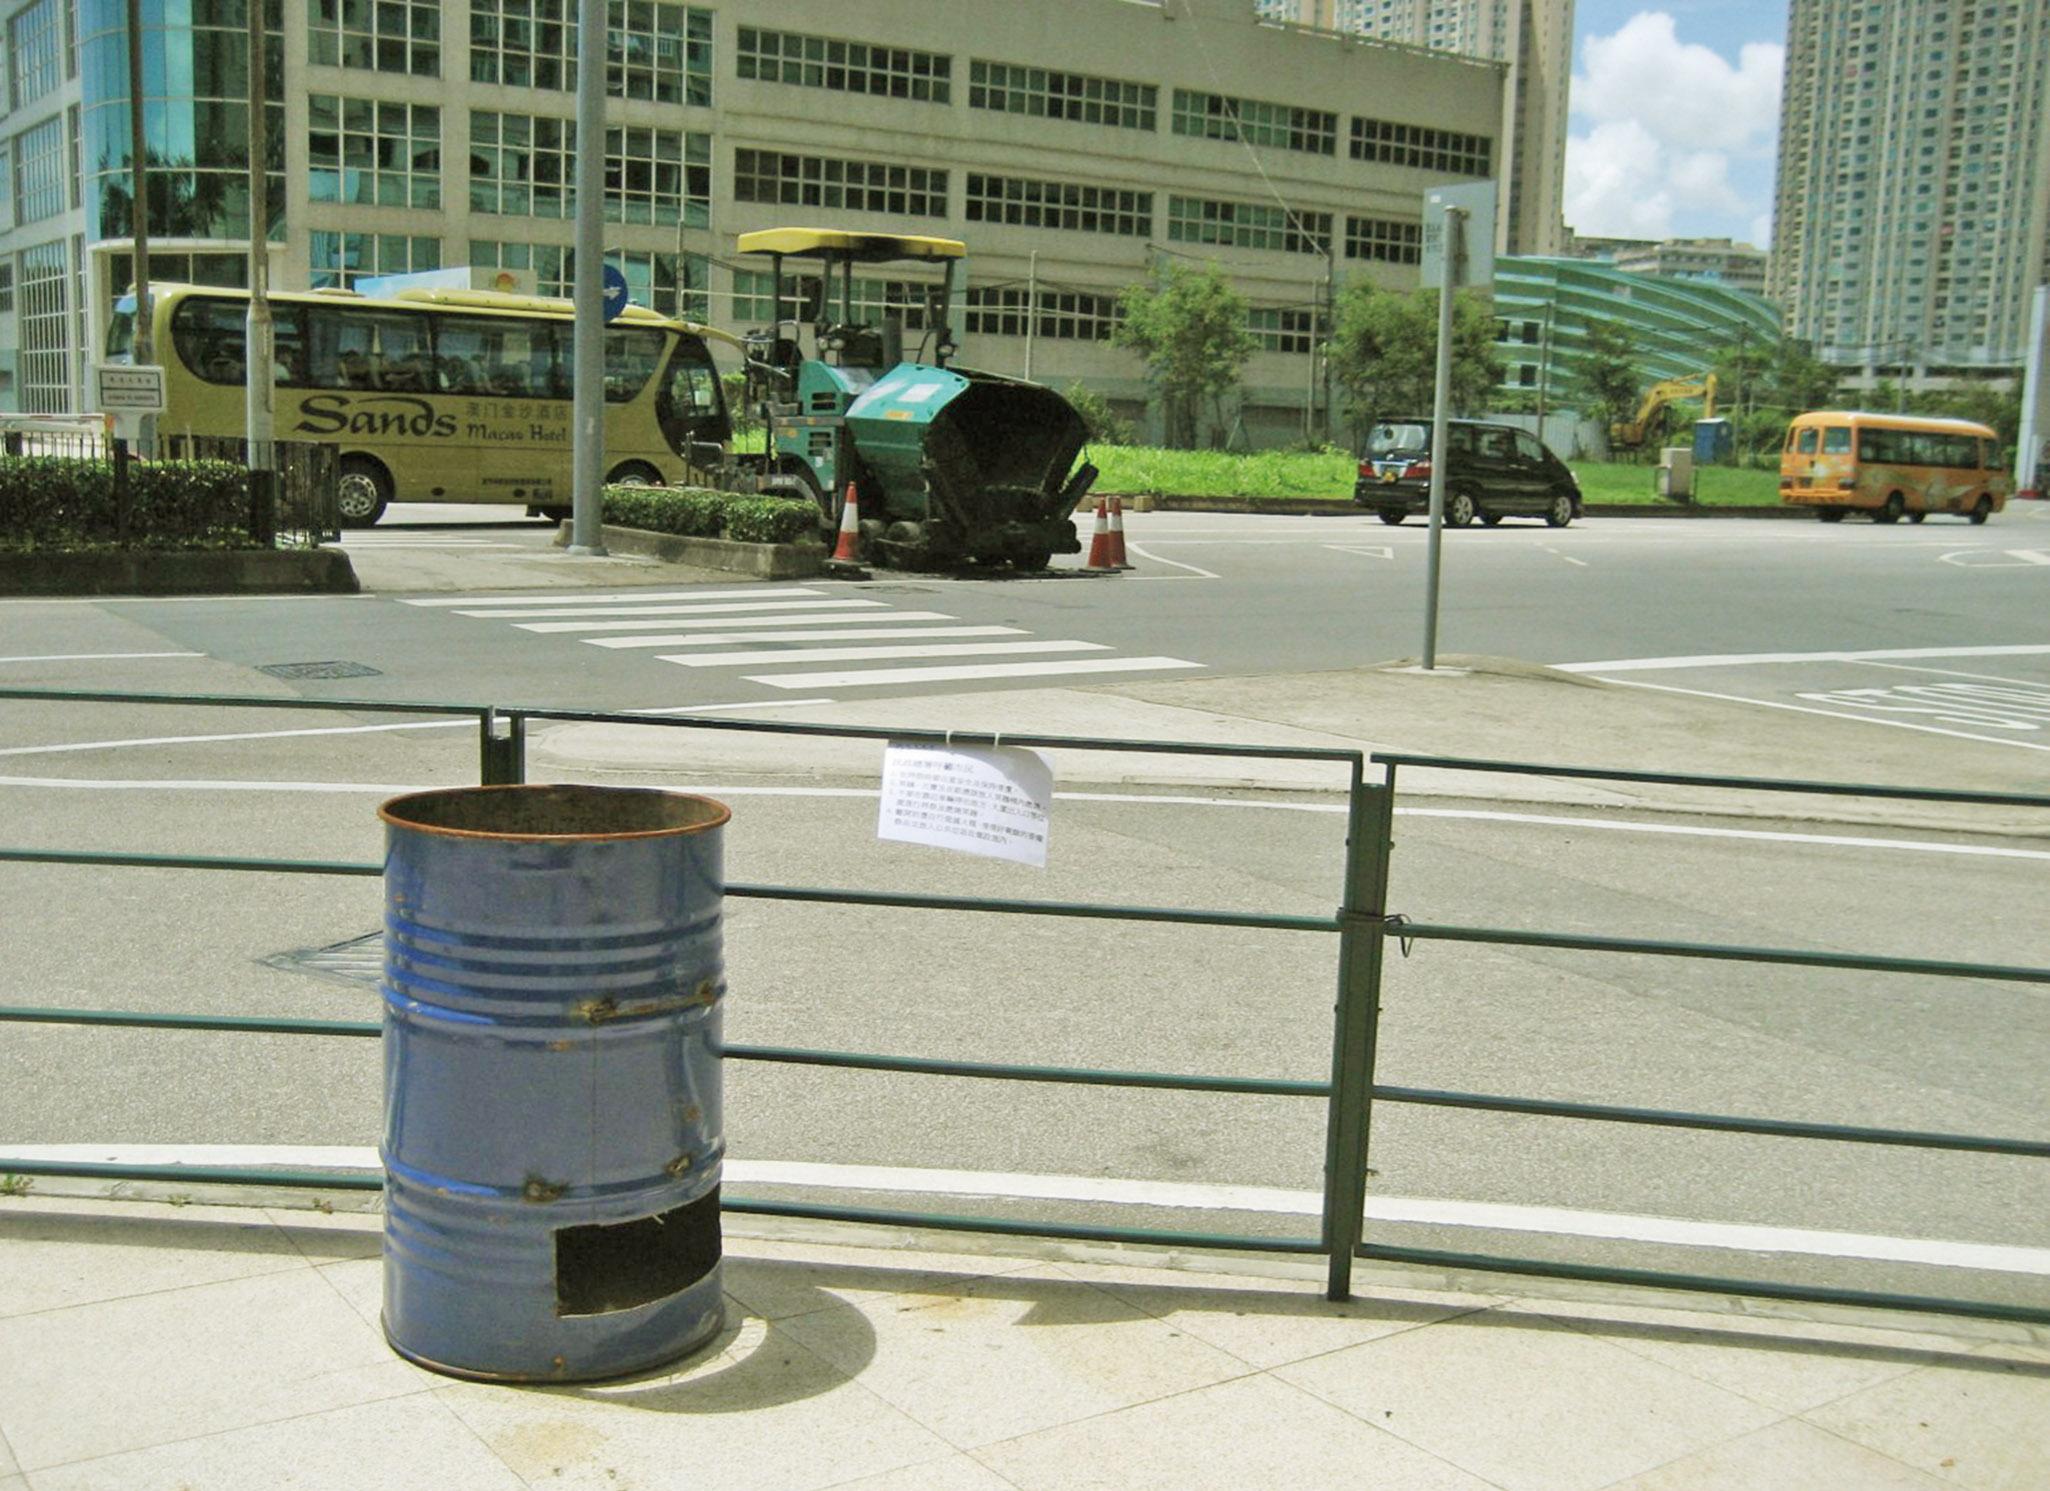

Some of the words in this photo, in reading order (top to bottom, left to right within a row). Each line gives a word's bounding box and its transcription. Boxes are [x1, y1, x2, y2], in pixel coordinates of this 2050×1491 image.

[292, 394, 458, 437] Sands
[466, 422, 524, 441] Macao
[529, 423, 567, 441] Hotel
